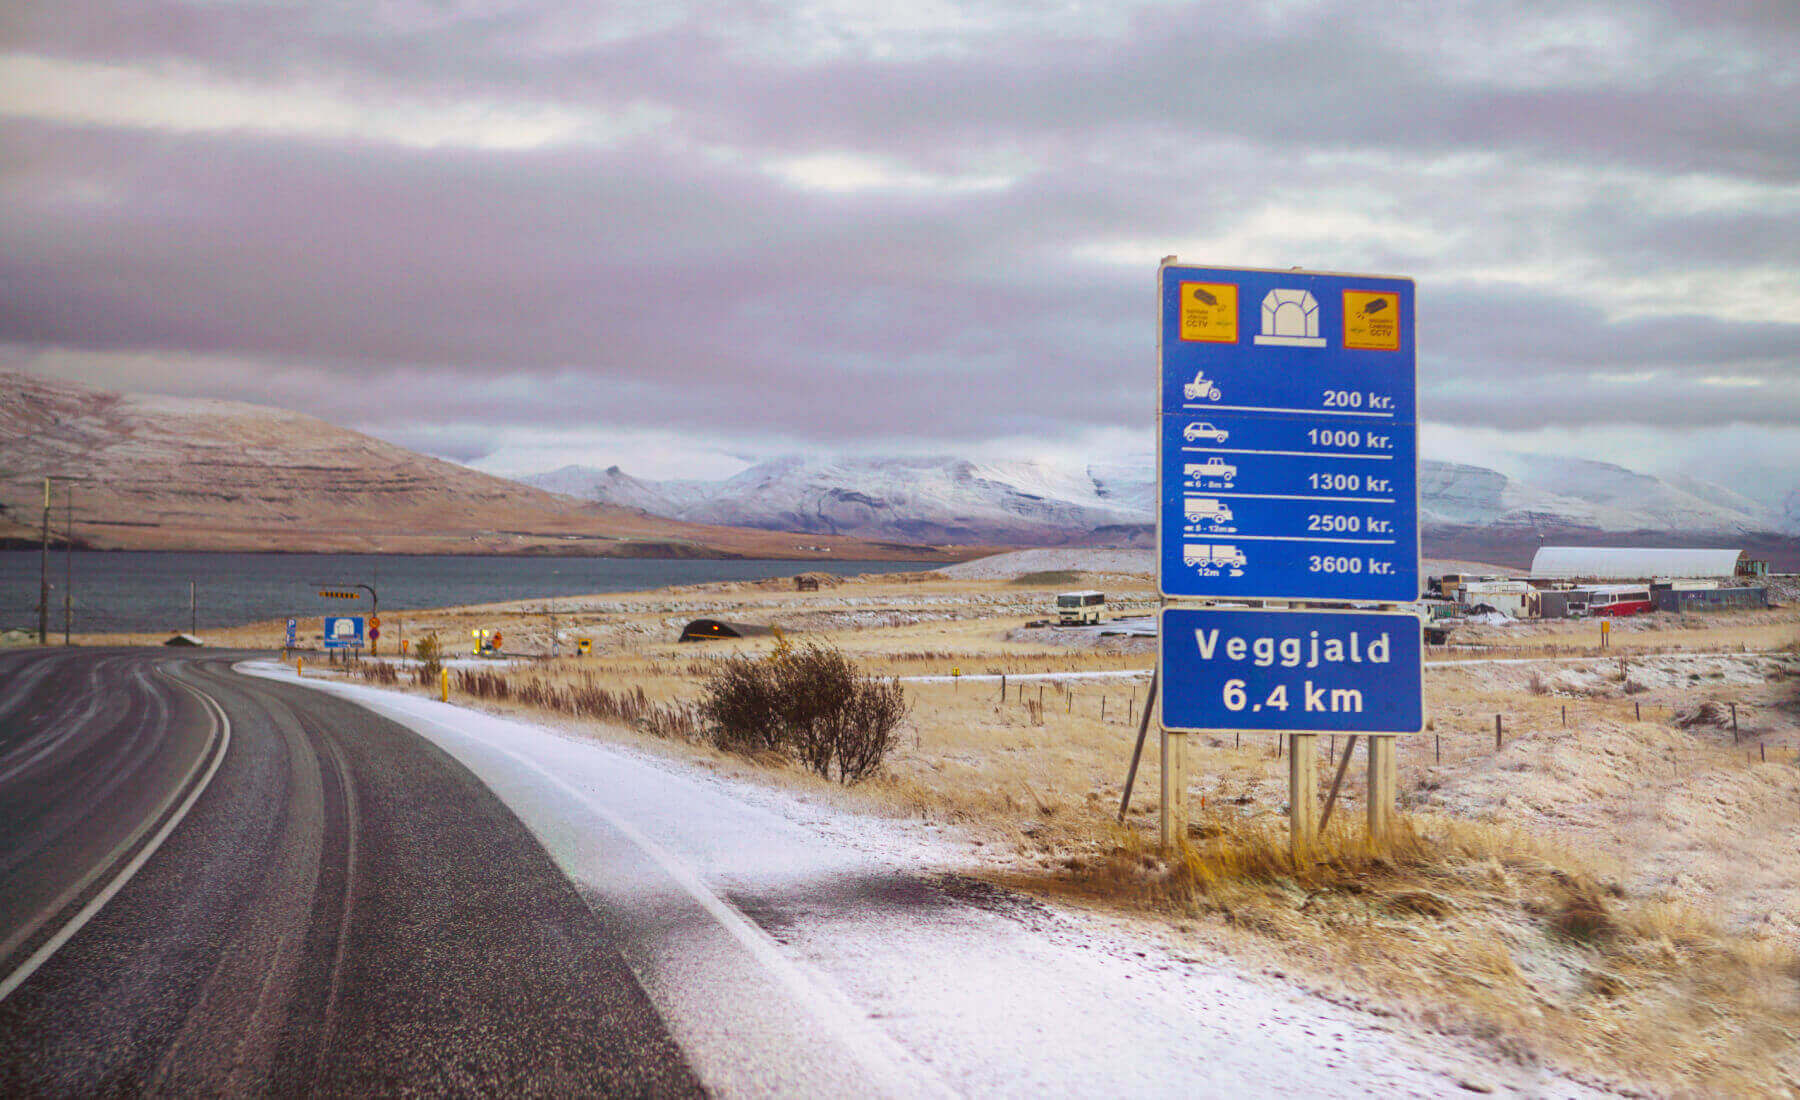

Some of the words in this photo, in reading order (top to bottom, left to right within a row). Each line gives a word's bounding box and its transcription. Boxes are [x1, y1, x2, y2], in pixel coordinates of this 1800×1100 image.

[1186, 320, 1208, 328] CCTV
[1370, 328, 1392, 337] CCTV
[1323, 390, 1361, 407] 200
[1369, 392, 1395, 408] kr.
[1308, 429, 1360, 447] 1000
[1367, 432, 1393, 448] kr.
[1309, 473, 1360, 491] 1300
[1367, 475, 1393, 492] kr.
[1308, 515, 1360, 532] 2500
[1367, 517, 1394, 533] kr.
[1197, 567, 1219, 577] 12m
[1309, 555, 1362, 573] 3600
[1369, 558, 1395, 575] kr.
[1194, 628, 1391, 669] Veggjald
[1222, 678, 1289, 712] 6.4
[1304, 681, 1363, 713] km
